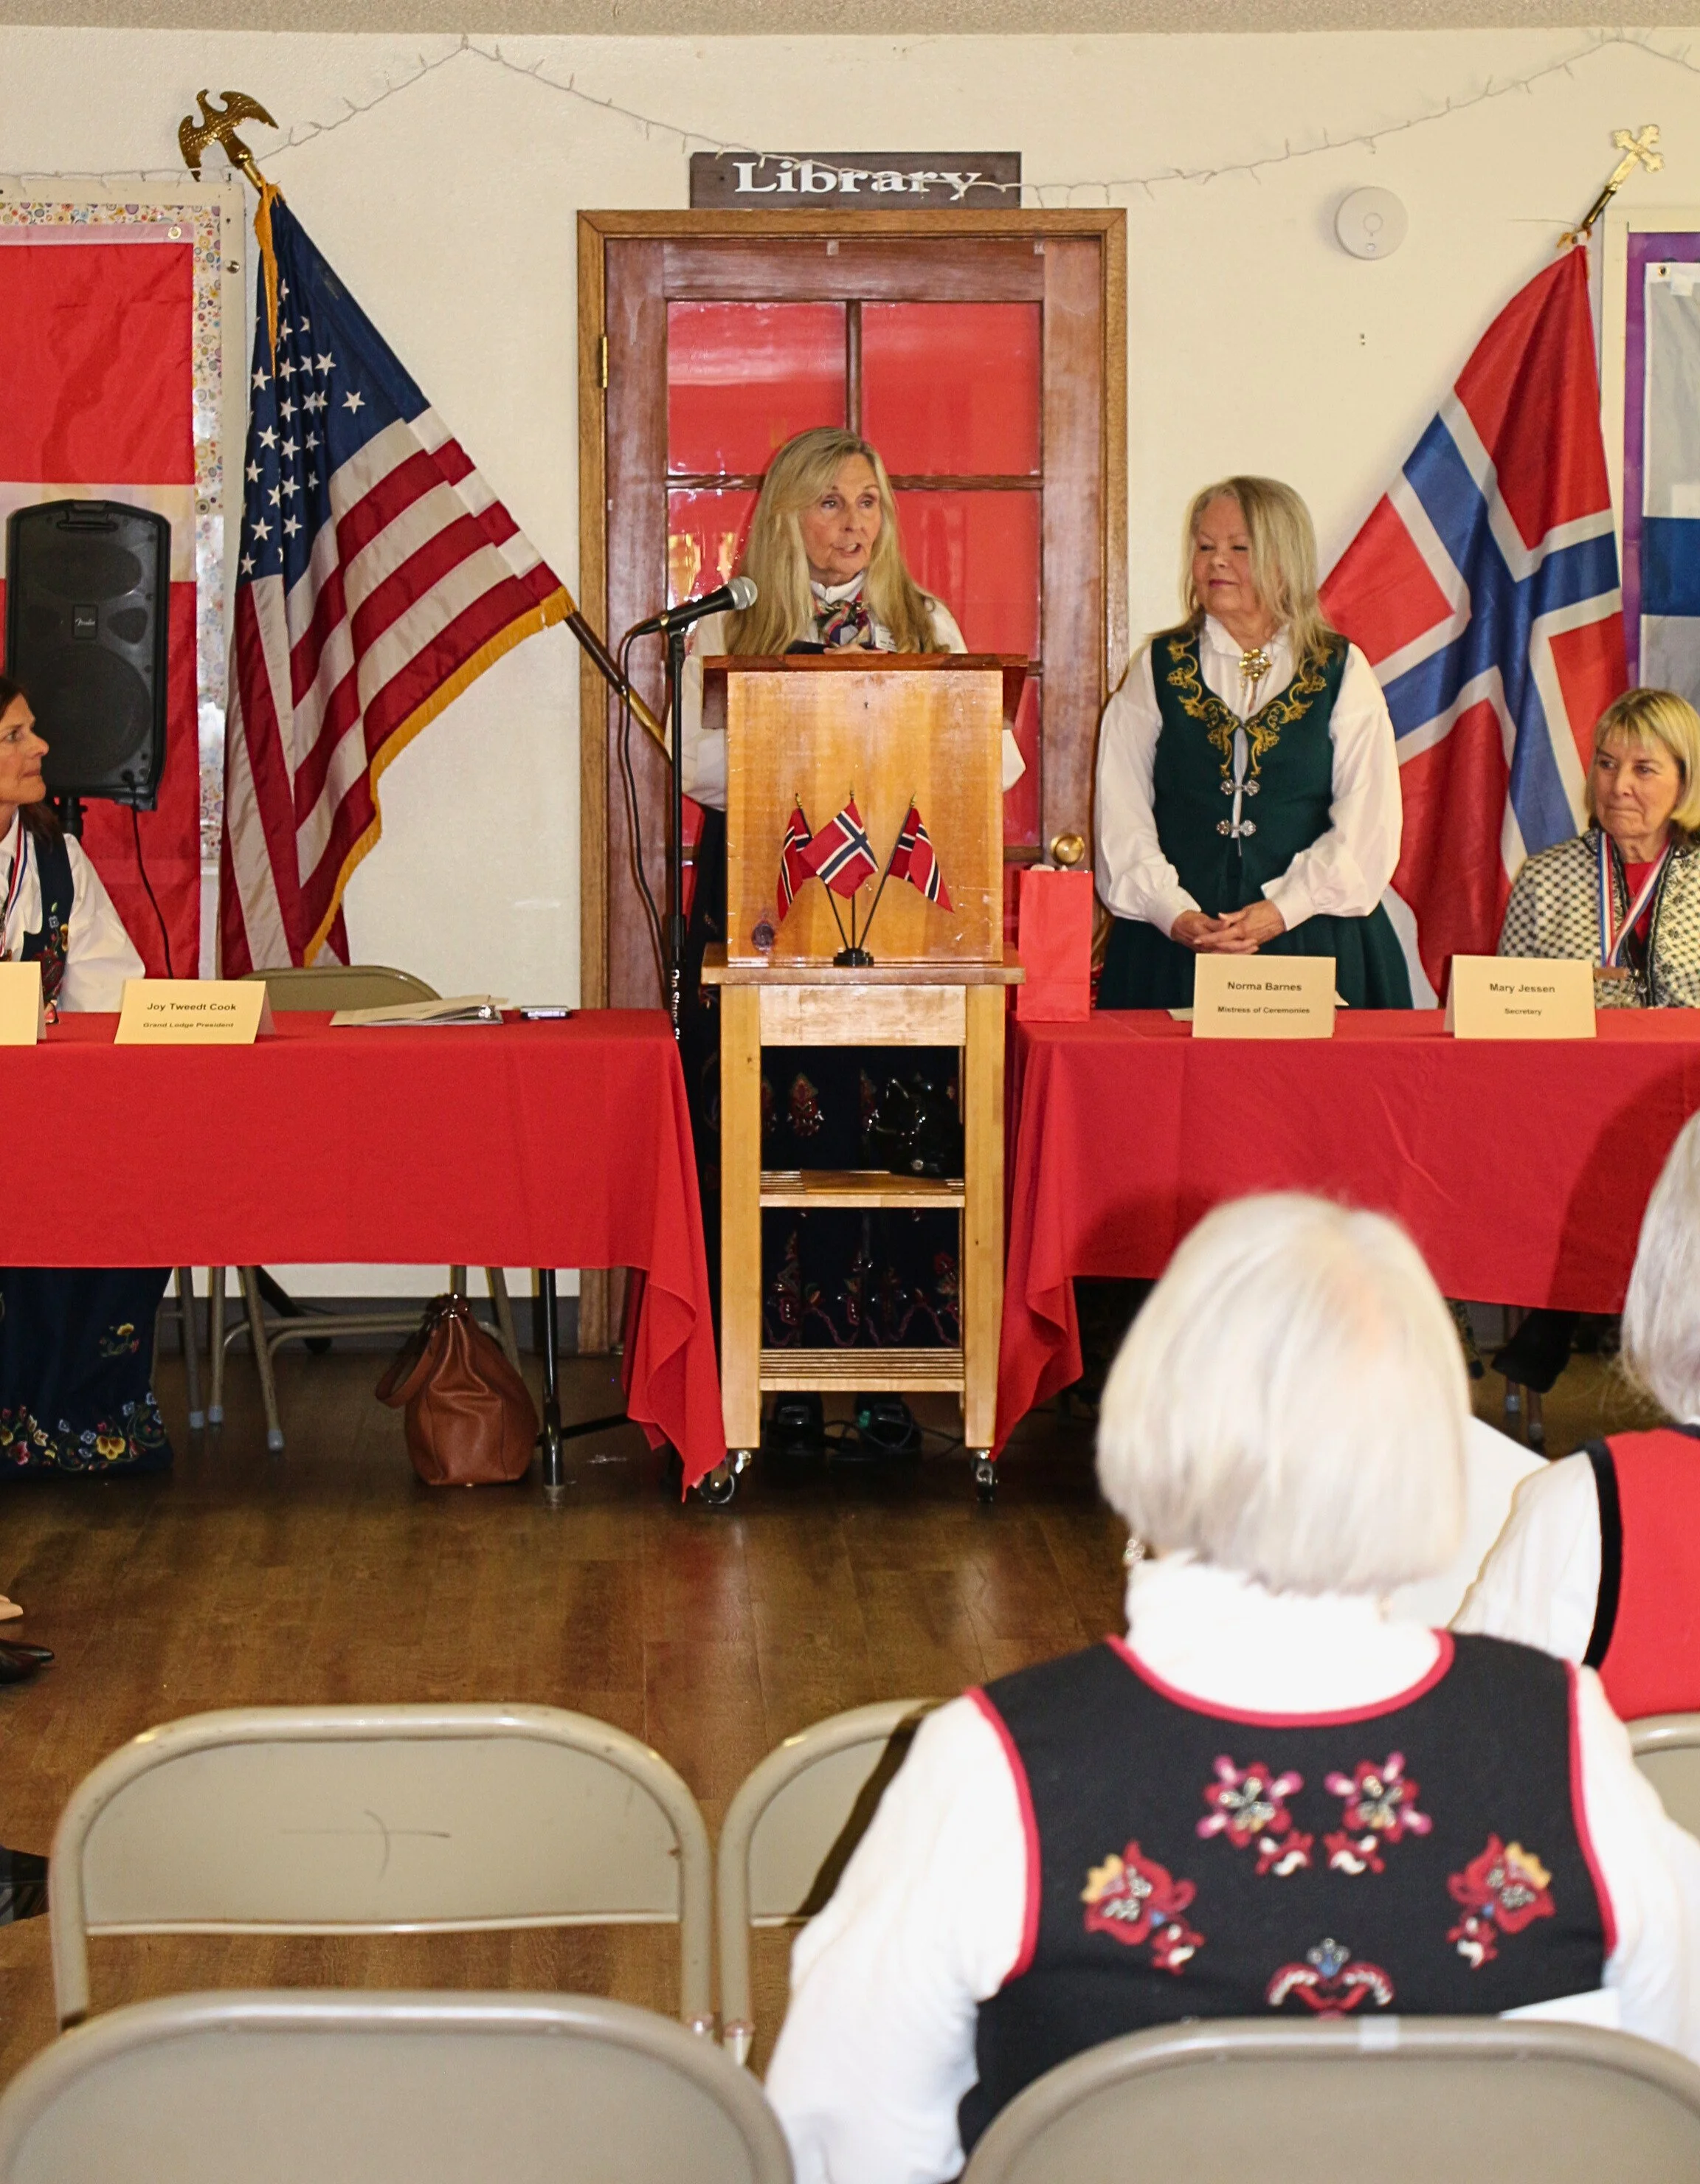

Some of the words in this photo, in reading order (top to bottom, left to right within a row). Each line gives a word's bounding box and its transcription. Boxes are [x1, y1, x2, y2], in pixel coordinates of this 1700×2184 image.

[733, 159, 982, 200] Library
[1227, 981, 1262, 990] Norma
[1265, 983, 1302, 991] Barnes
[1490, 983, 1516, 994] Mary
[1518, 984, 1555, 992] Jessen
[147, 1003, 166, 1012] Joy
[169, 1003, 207, 1011] Tweedt
[1504, 1008, 1543, 1016] Secretary
